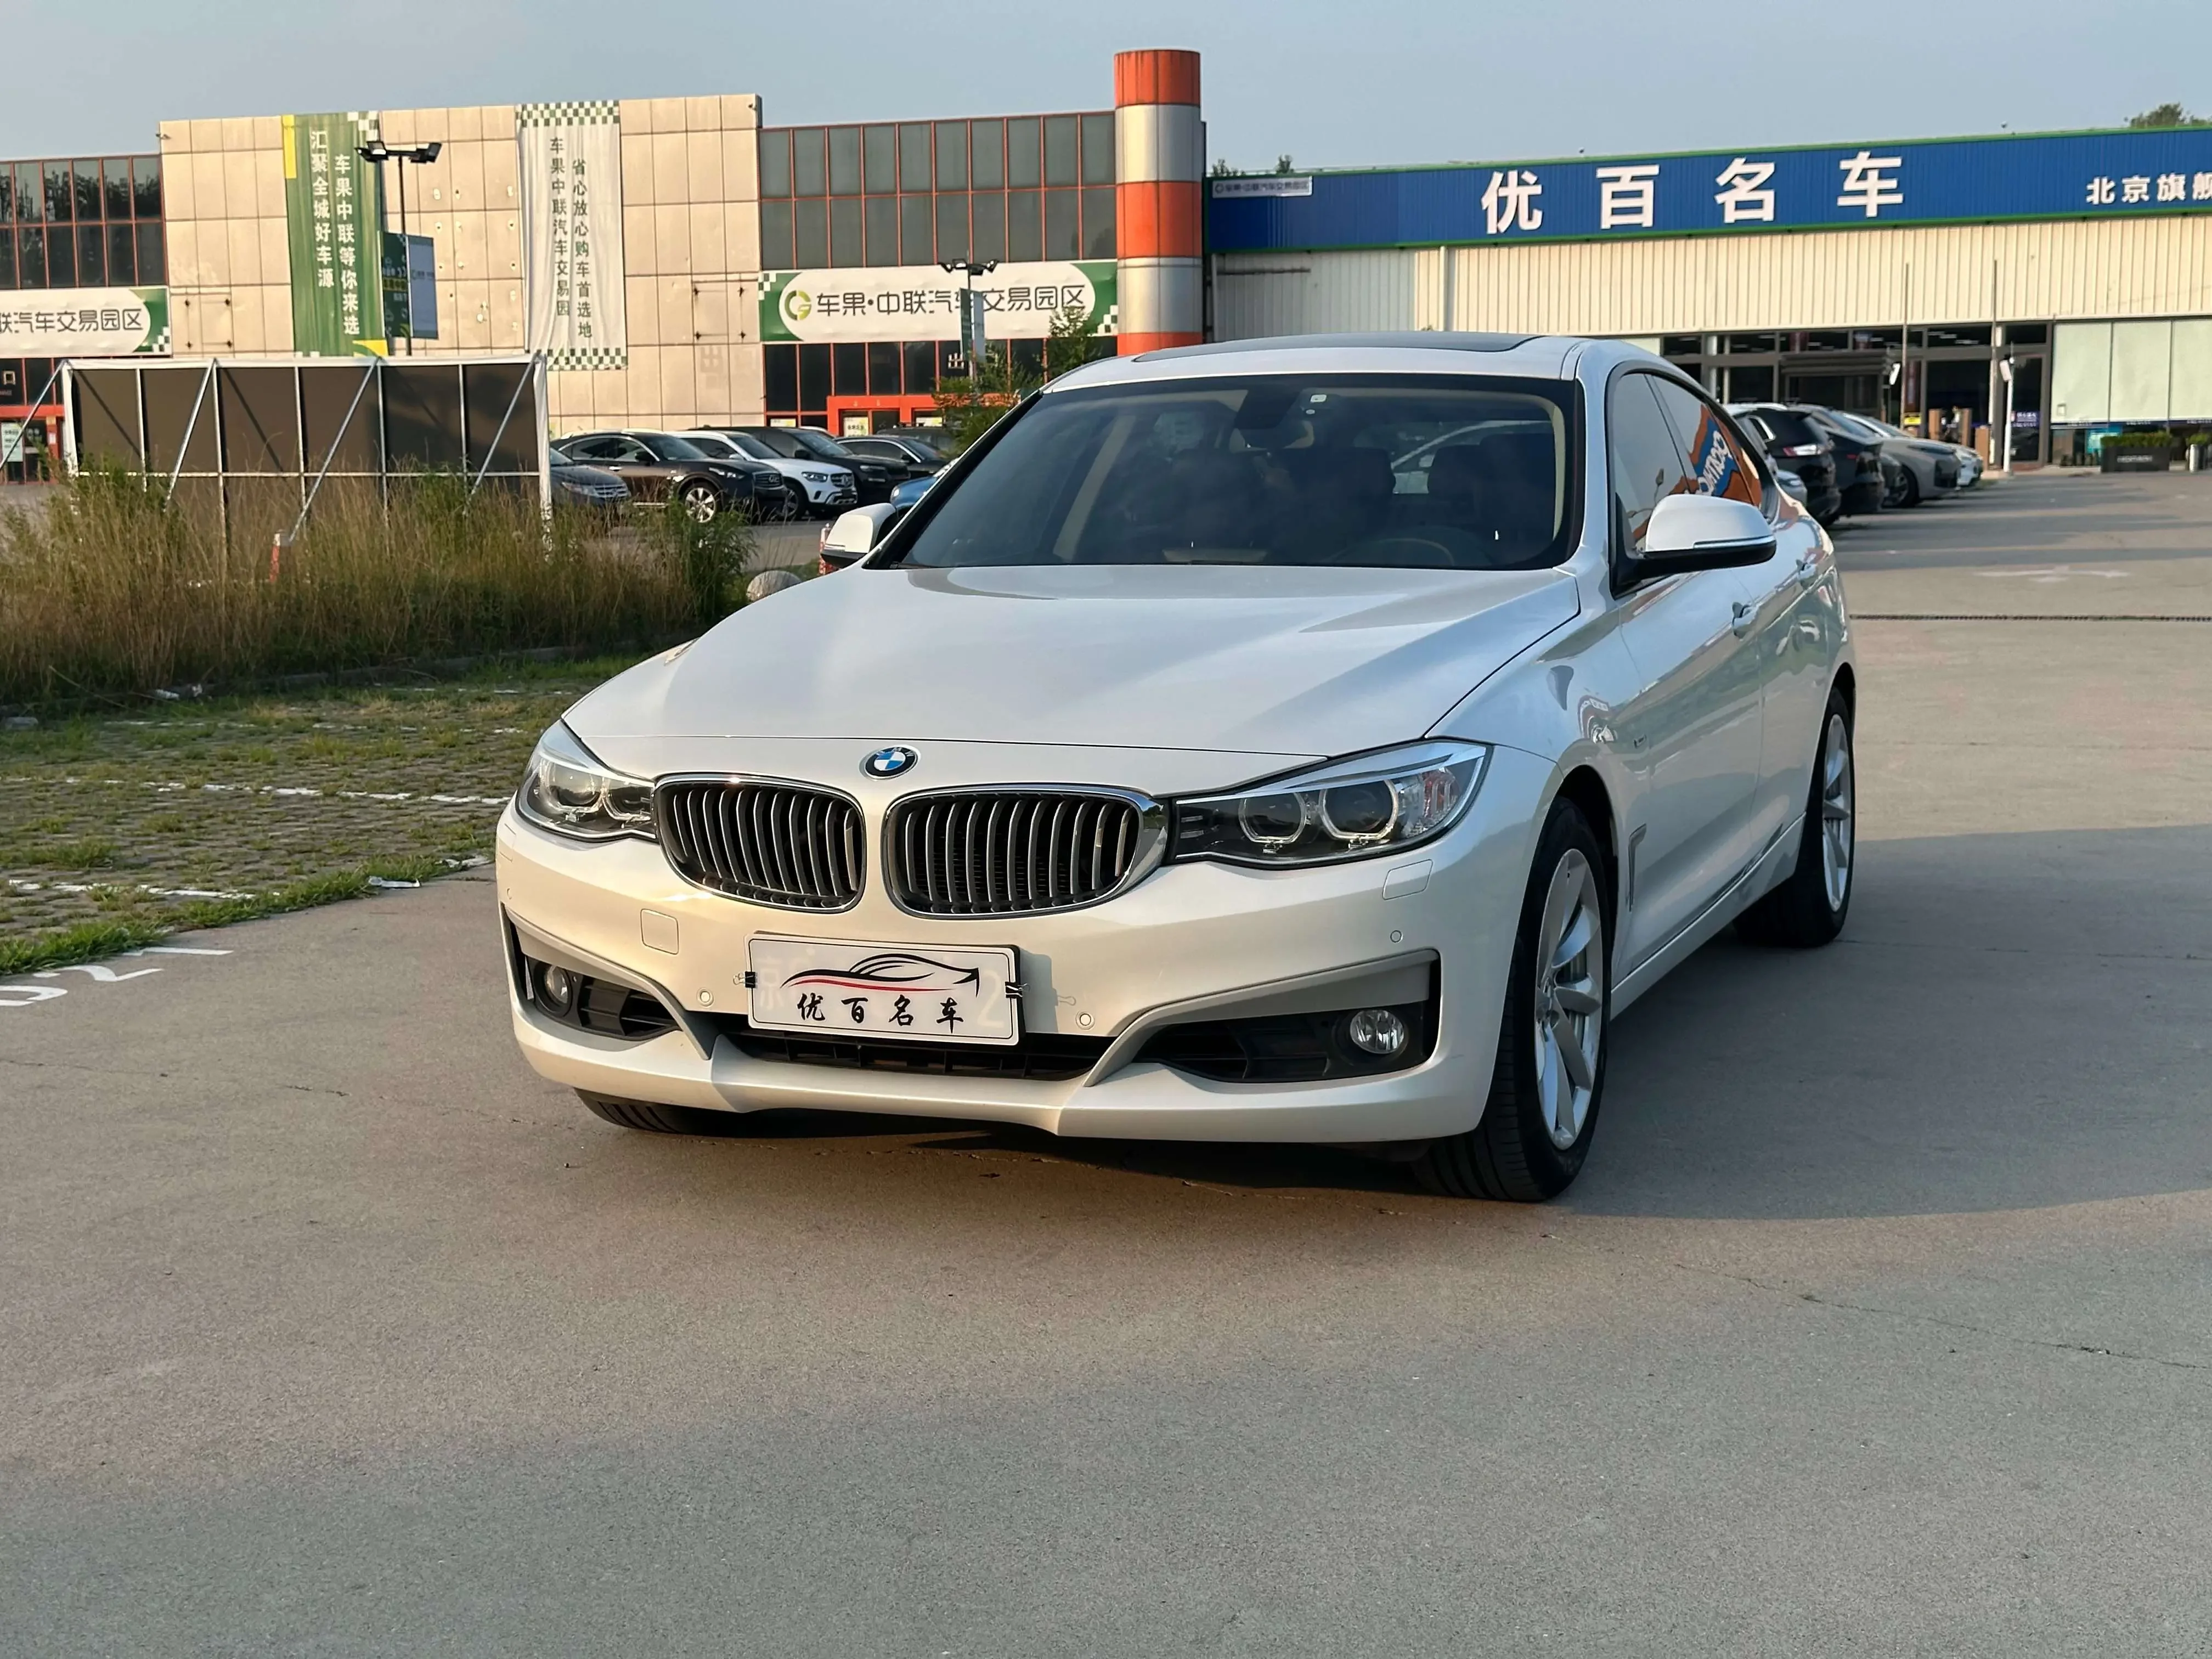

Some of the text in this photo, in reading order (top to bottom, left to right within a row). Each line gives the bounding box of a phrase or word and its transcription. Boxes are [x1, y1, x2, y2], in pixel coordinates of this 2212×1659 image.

[310, 130, 334, 288] 汇聚全城好车源
[334, 154, 360, 336] 车果中联等你来选
[572, 159, 592, 339] 省心放心购车首选地
[1481, 151, 1904, 235] 优百名车
[816, 284, 1086, 317] 车果·中联汽交易园区
[797, 992, 964, 1034] 优百名车
